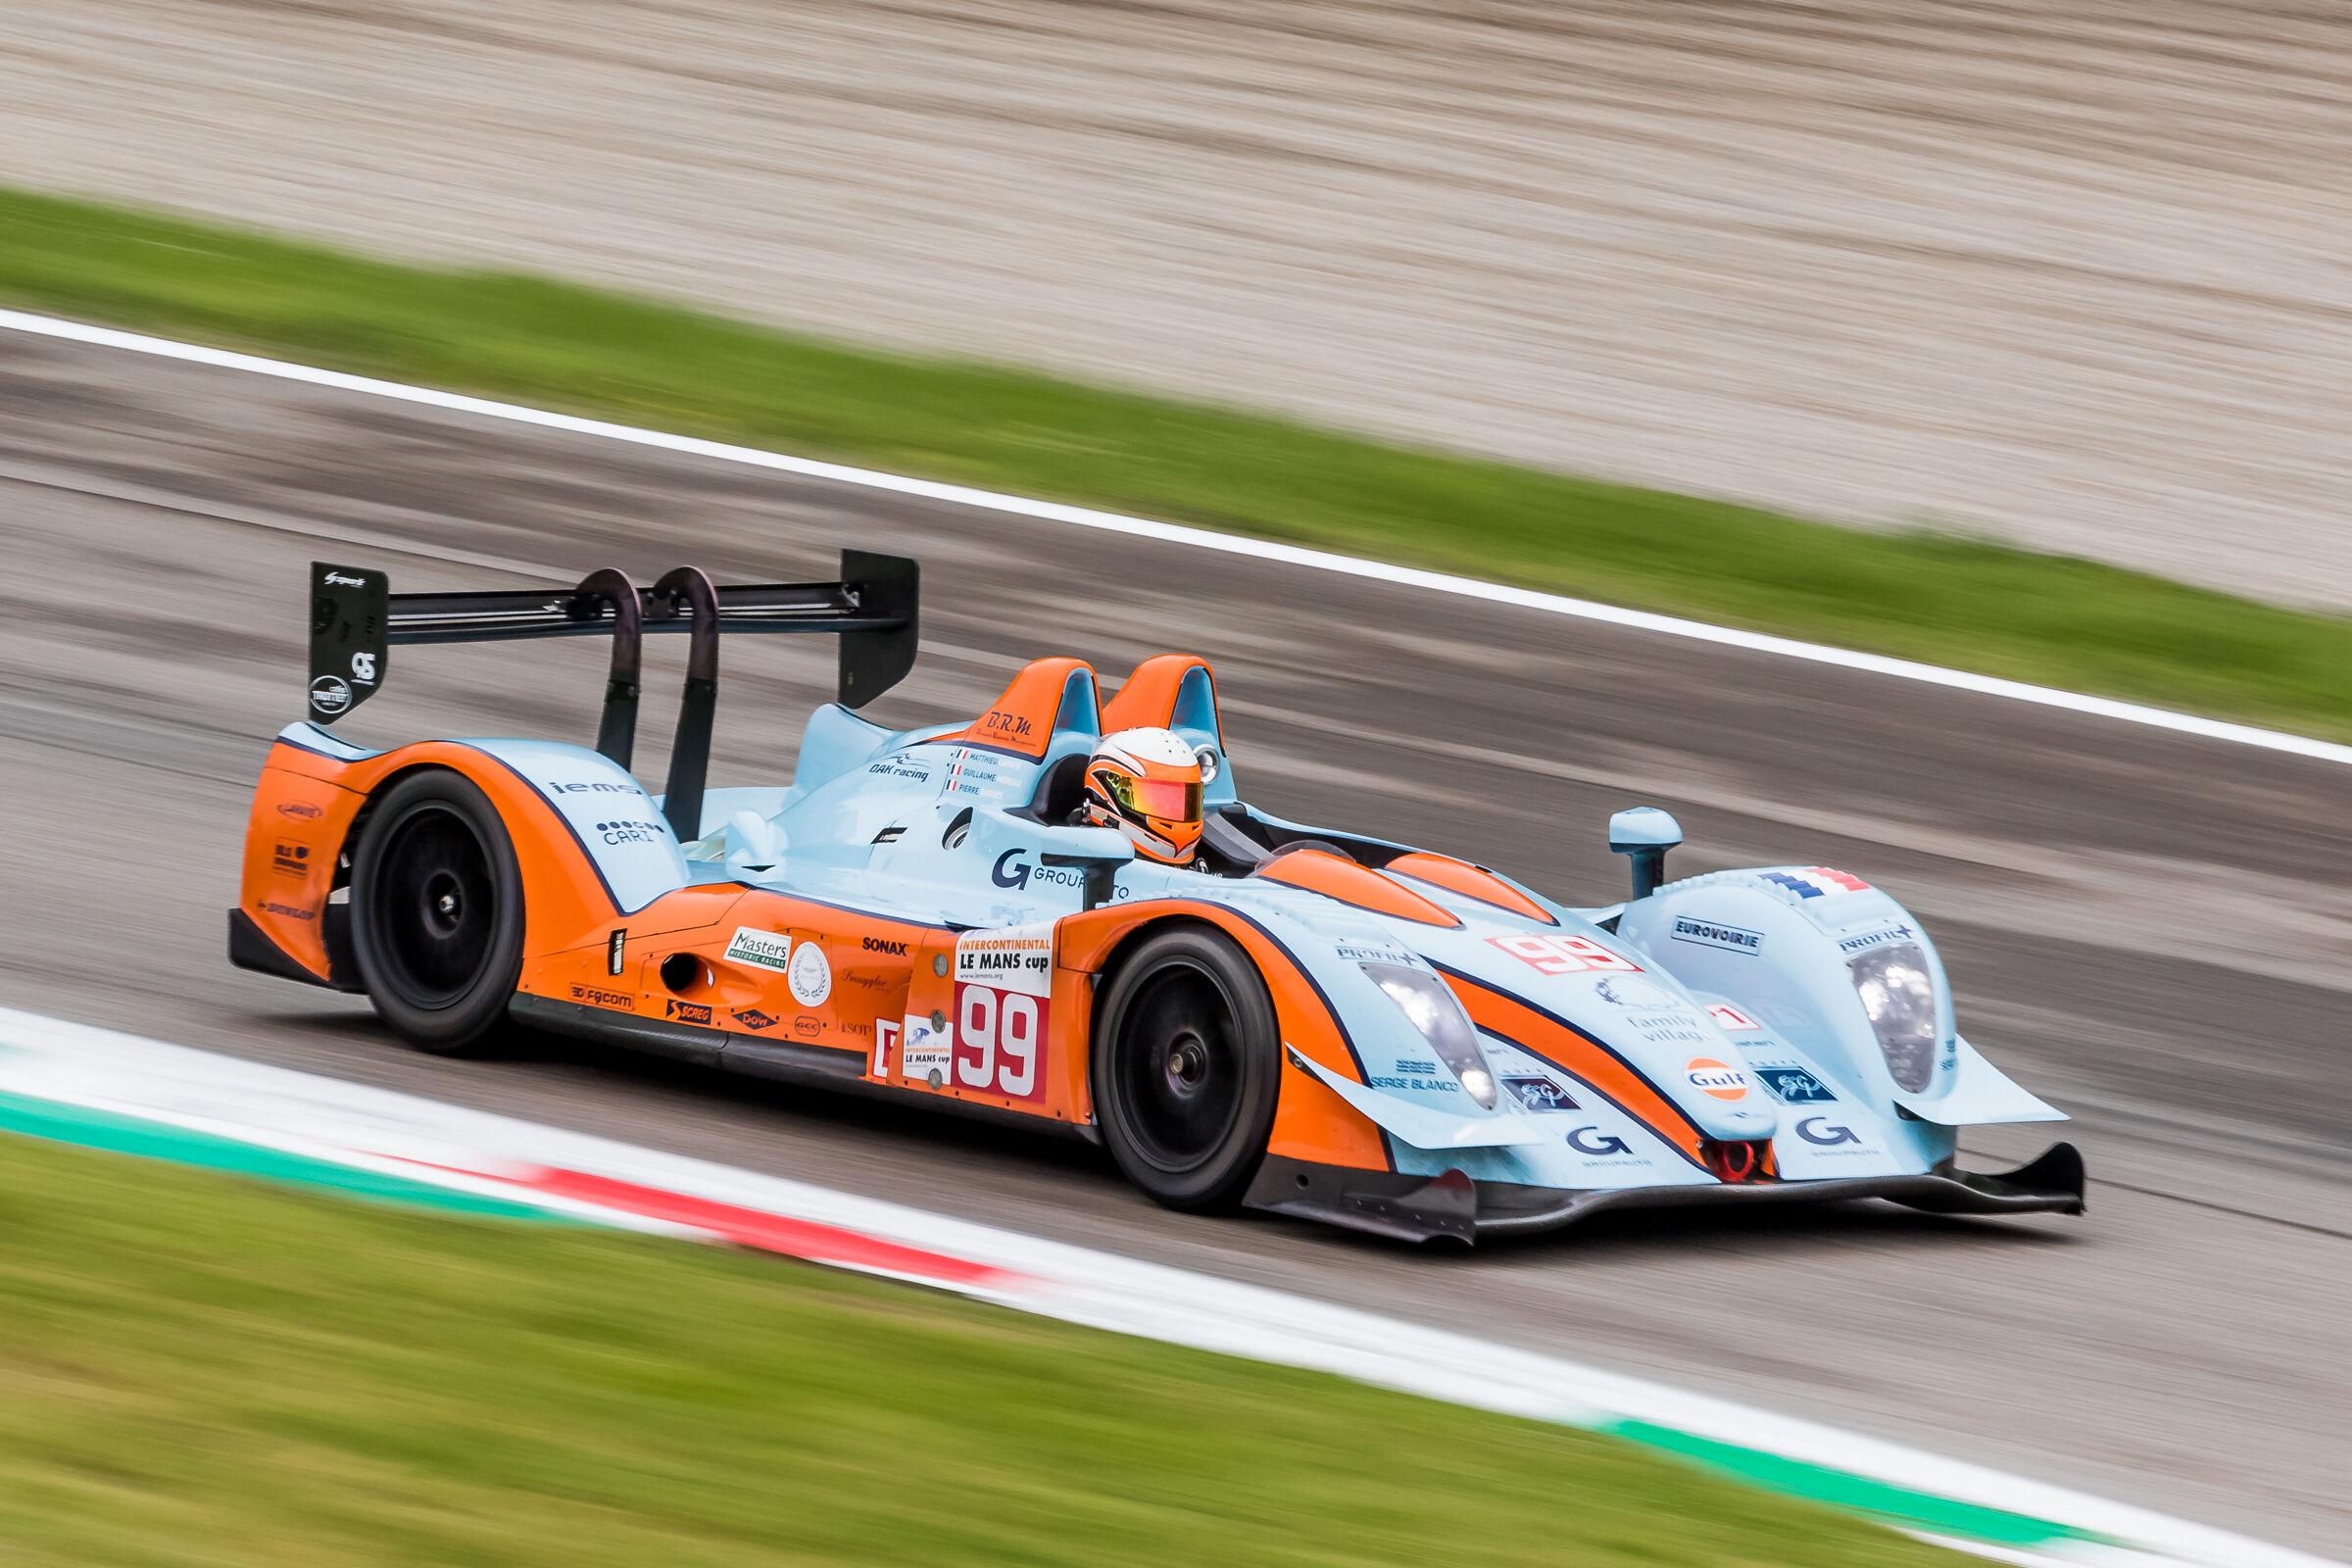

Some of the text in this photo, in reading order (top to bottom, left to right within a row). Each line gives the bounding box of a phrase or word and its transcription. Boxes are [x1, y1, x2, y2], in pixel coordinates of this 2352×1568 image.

[869, 763, 929, 783] OAK racing
[962, 767, 997, 782] GUILLAUME
[958, 783, 980, 795] PIERRE
[604, 830, 654, 846] CARI
[1676, 920, 1759, 948] EUROVOIRIE
[735, 932, 787, 958] Masters
[862, 937, 907, 956] SONAX
[959, 939, 1051, 951] INTERCONTINENTAL
[728, 949, 786, 968] HISTORIC RACING
[1494, 935, 1638, 973] 99
[960, 953, 1049, 973] LE MANS cup
[681, 1005, 709, 1021] SCREG
[742, 1012, 768, 1027] DOW
[1626, 1014, 1698, 1028] family
[957, 984, 1039, 1097] 99
[1640, 1028, 1715, 1044] village
[906, 1054, 951, 1065] LE MANS cup
[1371, 1076, 1459, 1093] SERGE BLANCO
[1689, 1072, 1747, 1087] Gulf
